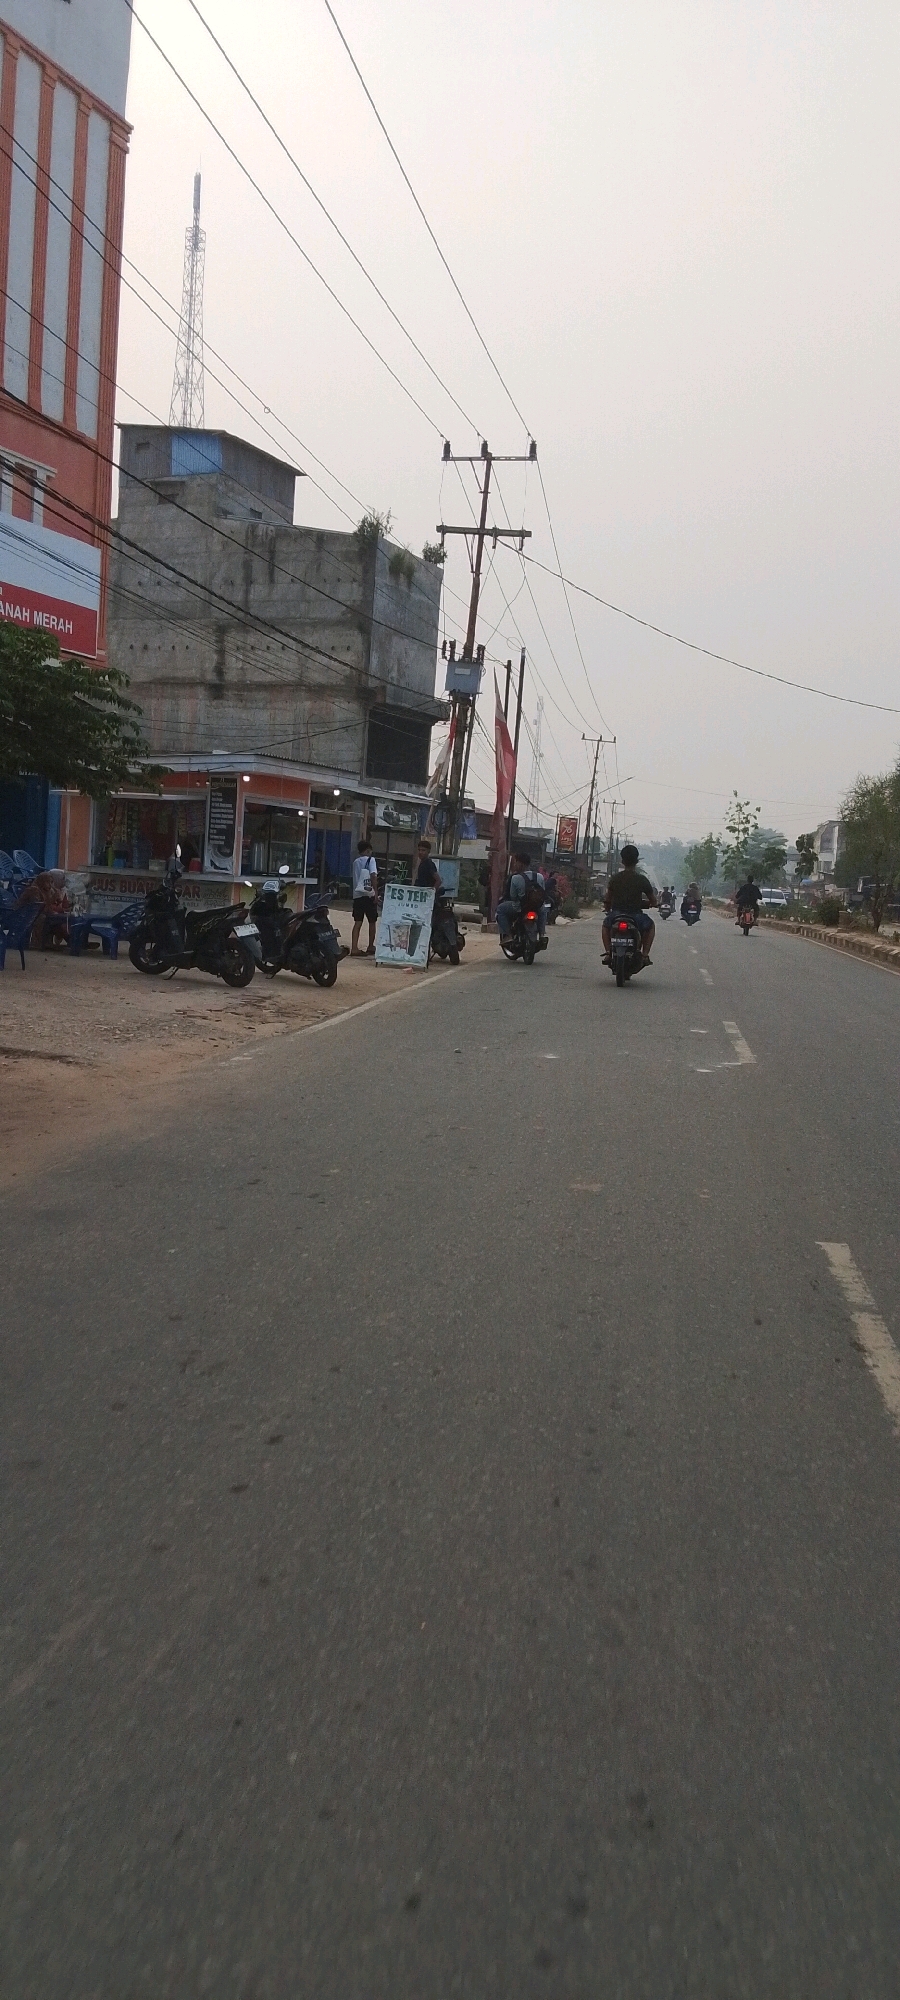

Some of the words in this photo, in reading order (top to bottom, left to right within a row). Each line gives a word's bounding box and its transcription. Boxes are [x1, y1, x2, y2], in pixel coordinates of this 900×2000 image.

[34, 611, 73, 634] MERAH
[92, 878, 117, 893] JUS
[390, 887, 405, 901] ES
[407, 889, 428, 903] TEH
